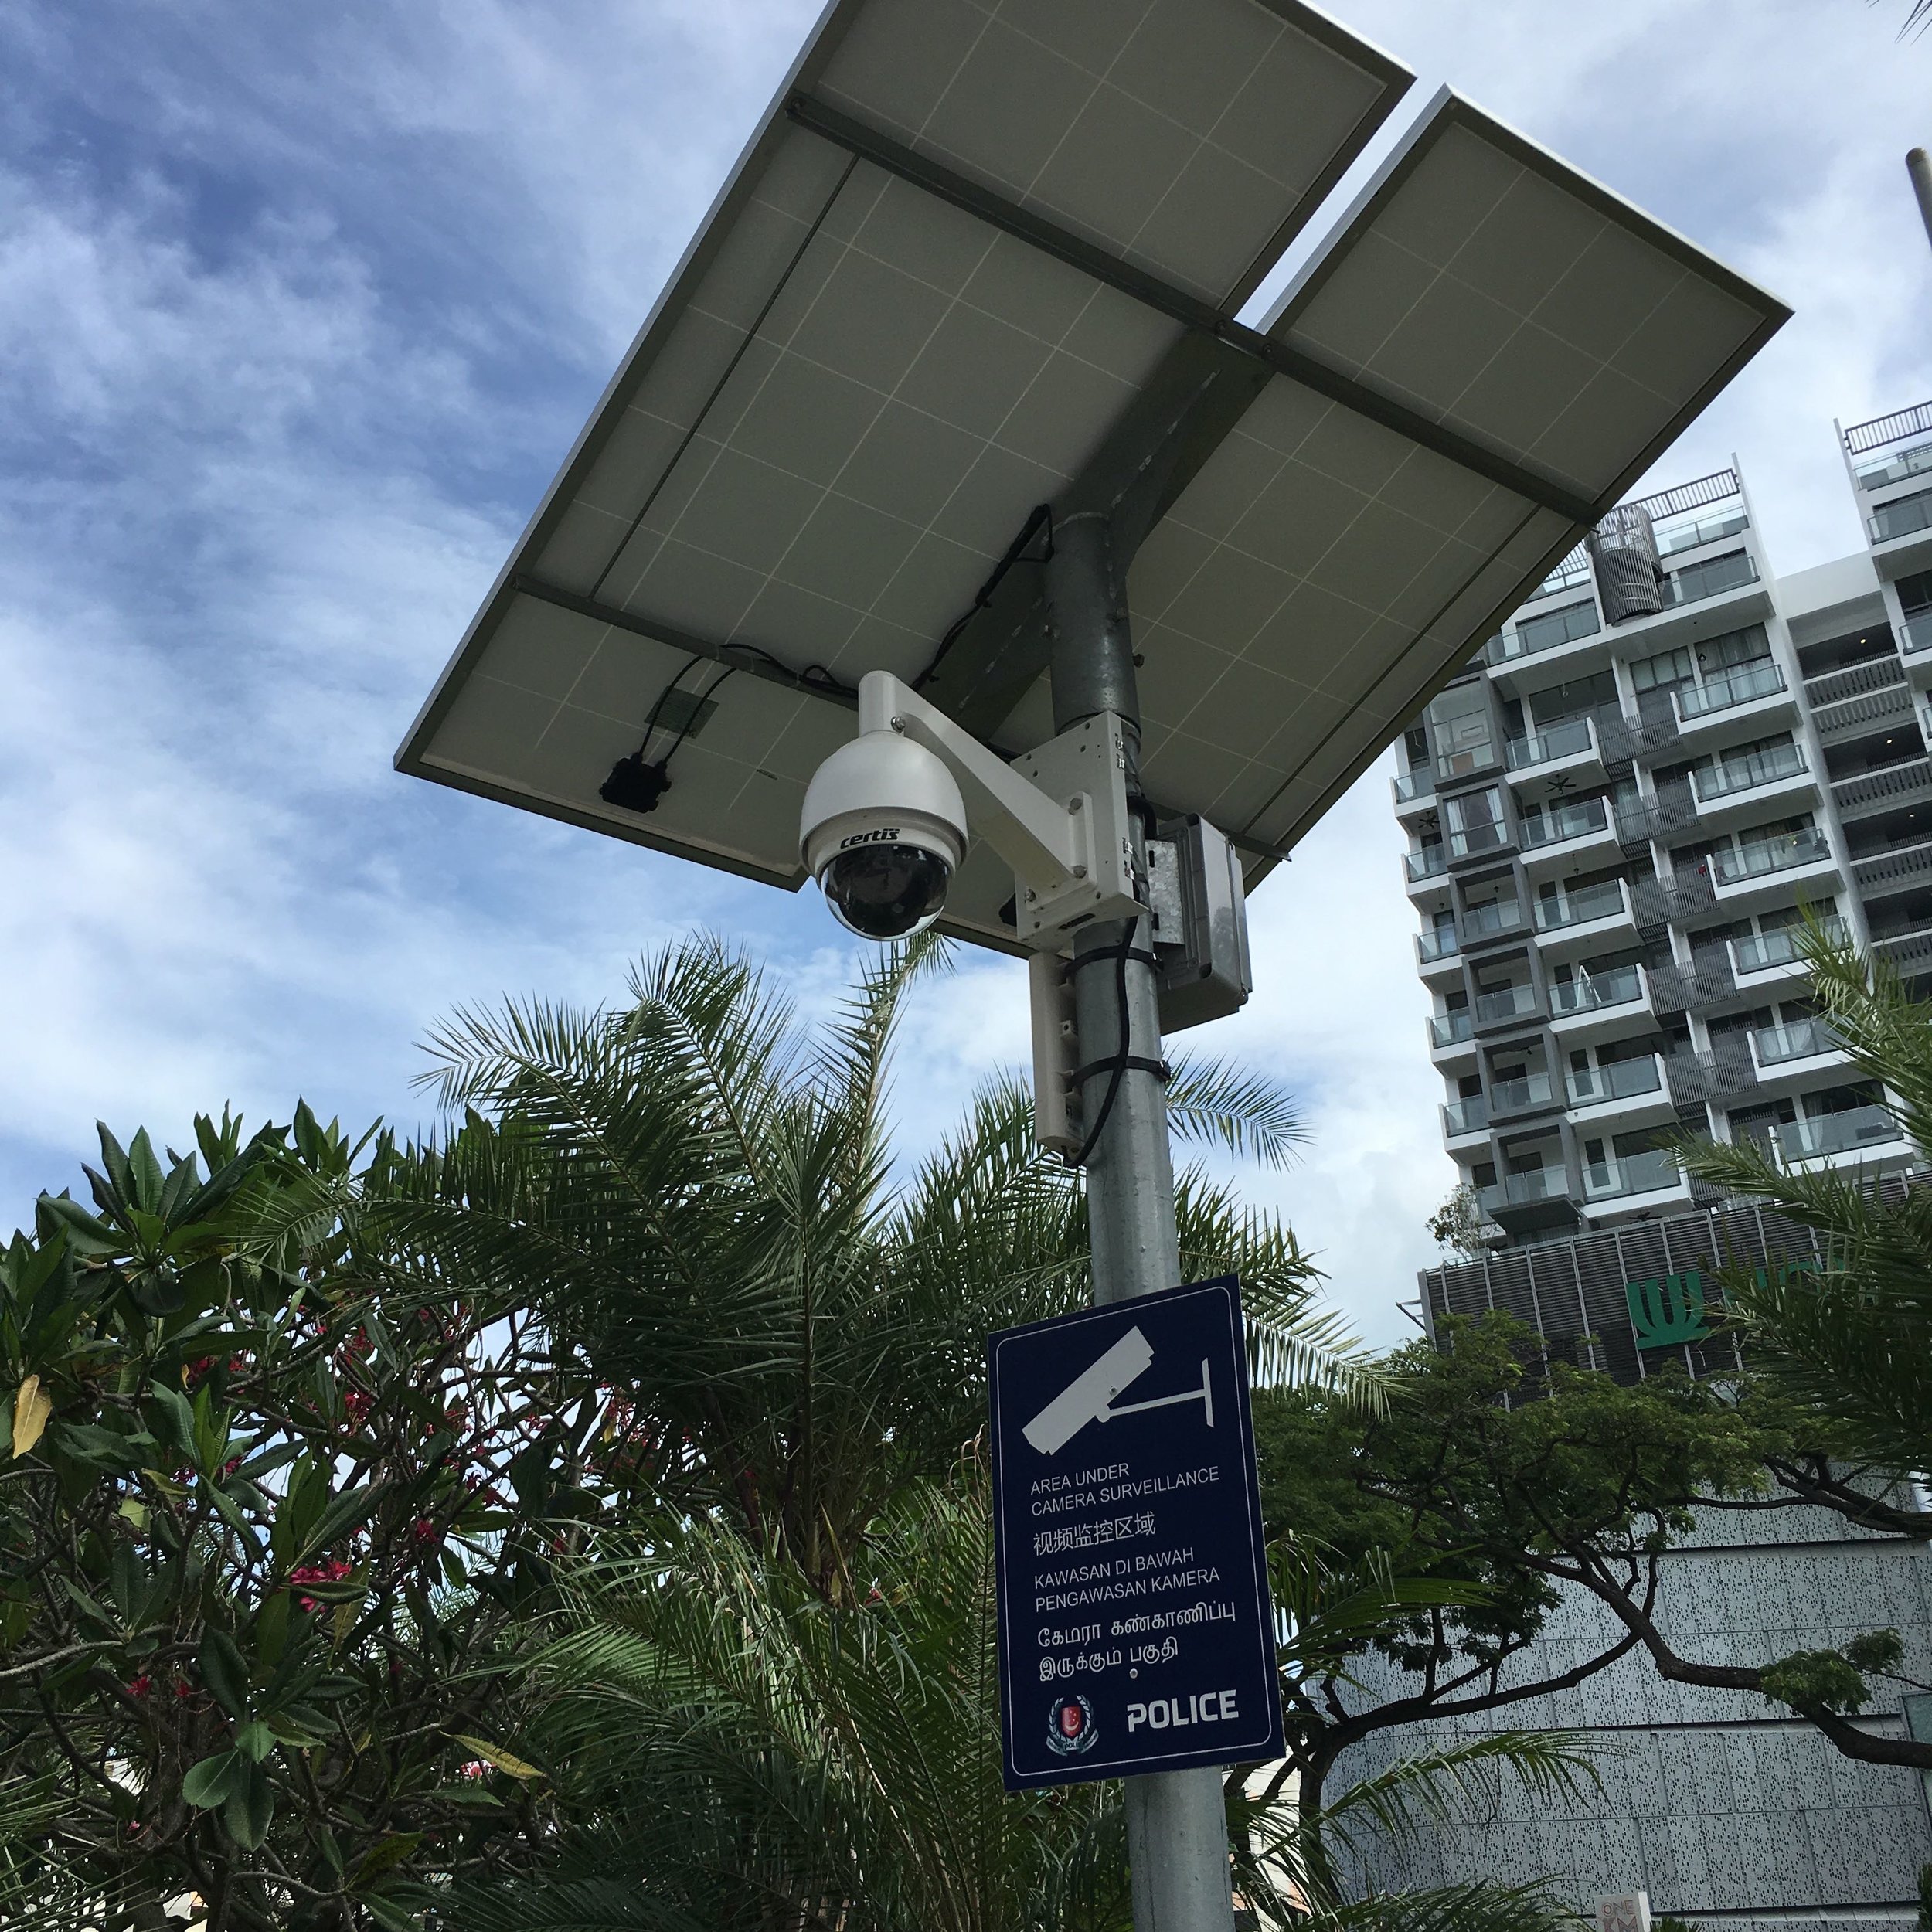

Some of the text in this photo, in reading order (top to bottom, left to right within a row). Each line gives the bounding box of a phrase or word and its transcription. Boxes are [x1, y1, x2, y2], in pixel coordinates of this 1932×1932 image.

[840, 828, 900, 849] certis
[1030, 1462, 1130, 1496] AREA UNDER
[1032, 1465, 1219, 1516] CAMERA SURVEILLANCE
[1032, 1511, 1156, 1556] 视频监控区域
[1034, 1546, 1194, 1590] KAWASAN DI BAWAH
[1036, 1566, 1220, 1613] PENGAWASAN KAMERA
[1037, 1600, 1236, 1648] கேமரா கண்காணிப்பு
[1039, 1636, 1179, 1682] இருக்கும் பகுதி
[1127, 1689, 1240, 1733] POLICE
[1602, 1900, 1635, 1917] ONE
